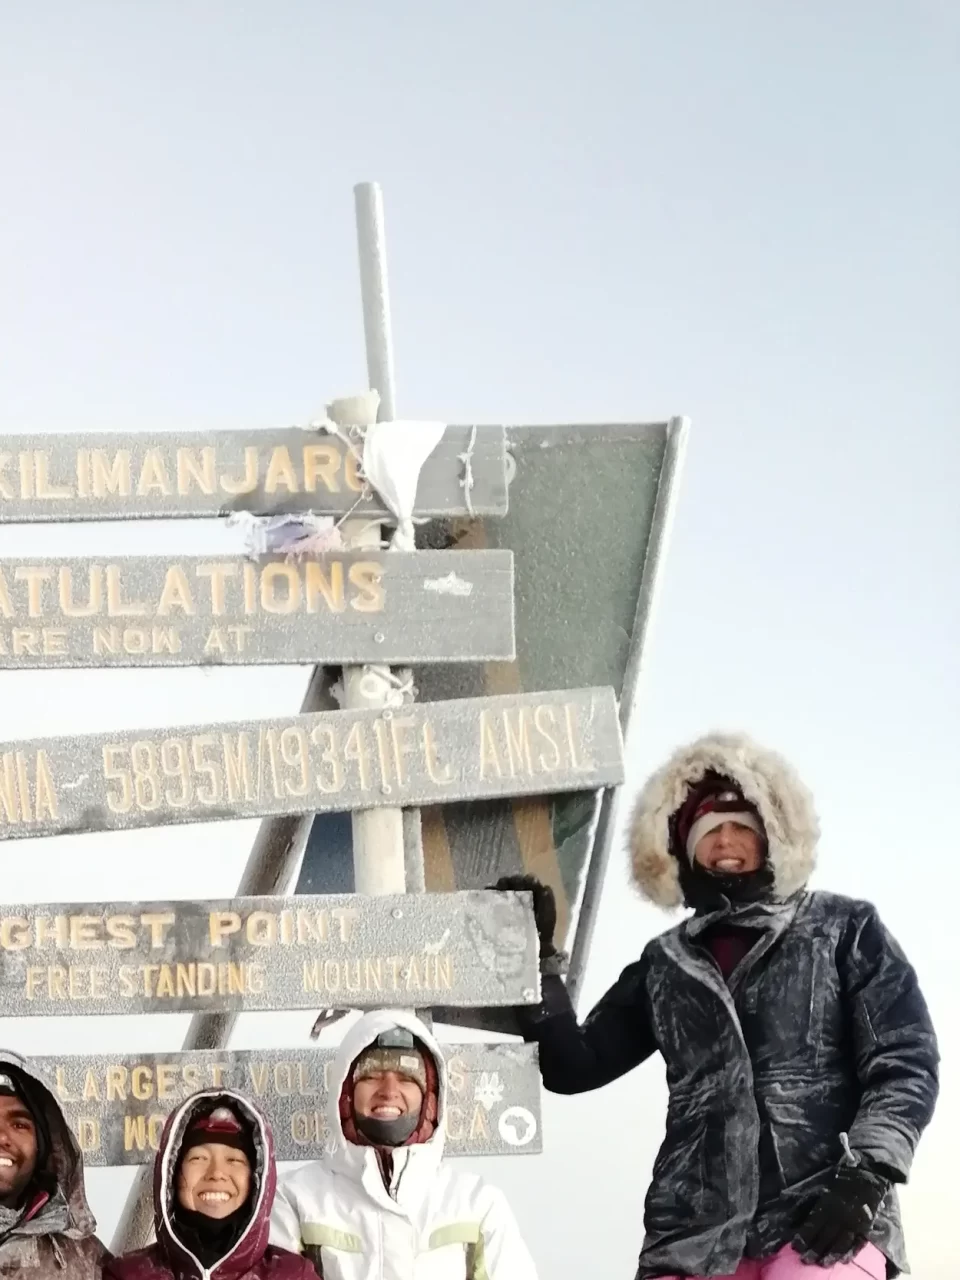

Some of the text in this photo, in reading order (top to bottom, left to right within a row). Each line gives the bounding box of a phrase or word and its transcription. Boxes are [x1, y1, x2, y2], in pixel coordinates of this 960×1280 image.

[92, 624, 182, 655] NOW
[203, 627, 254, 652] AT
[478, 702, 598, 782] AMSL
[208, 907, 360, 947] POINT
[303, 954, 455, 994] MOUNTAIN
[55, 1061, 230, 1102] LARGEST
